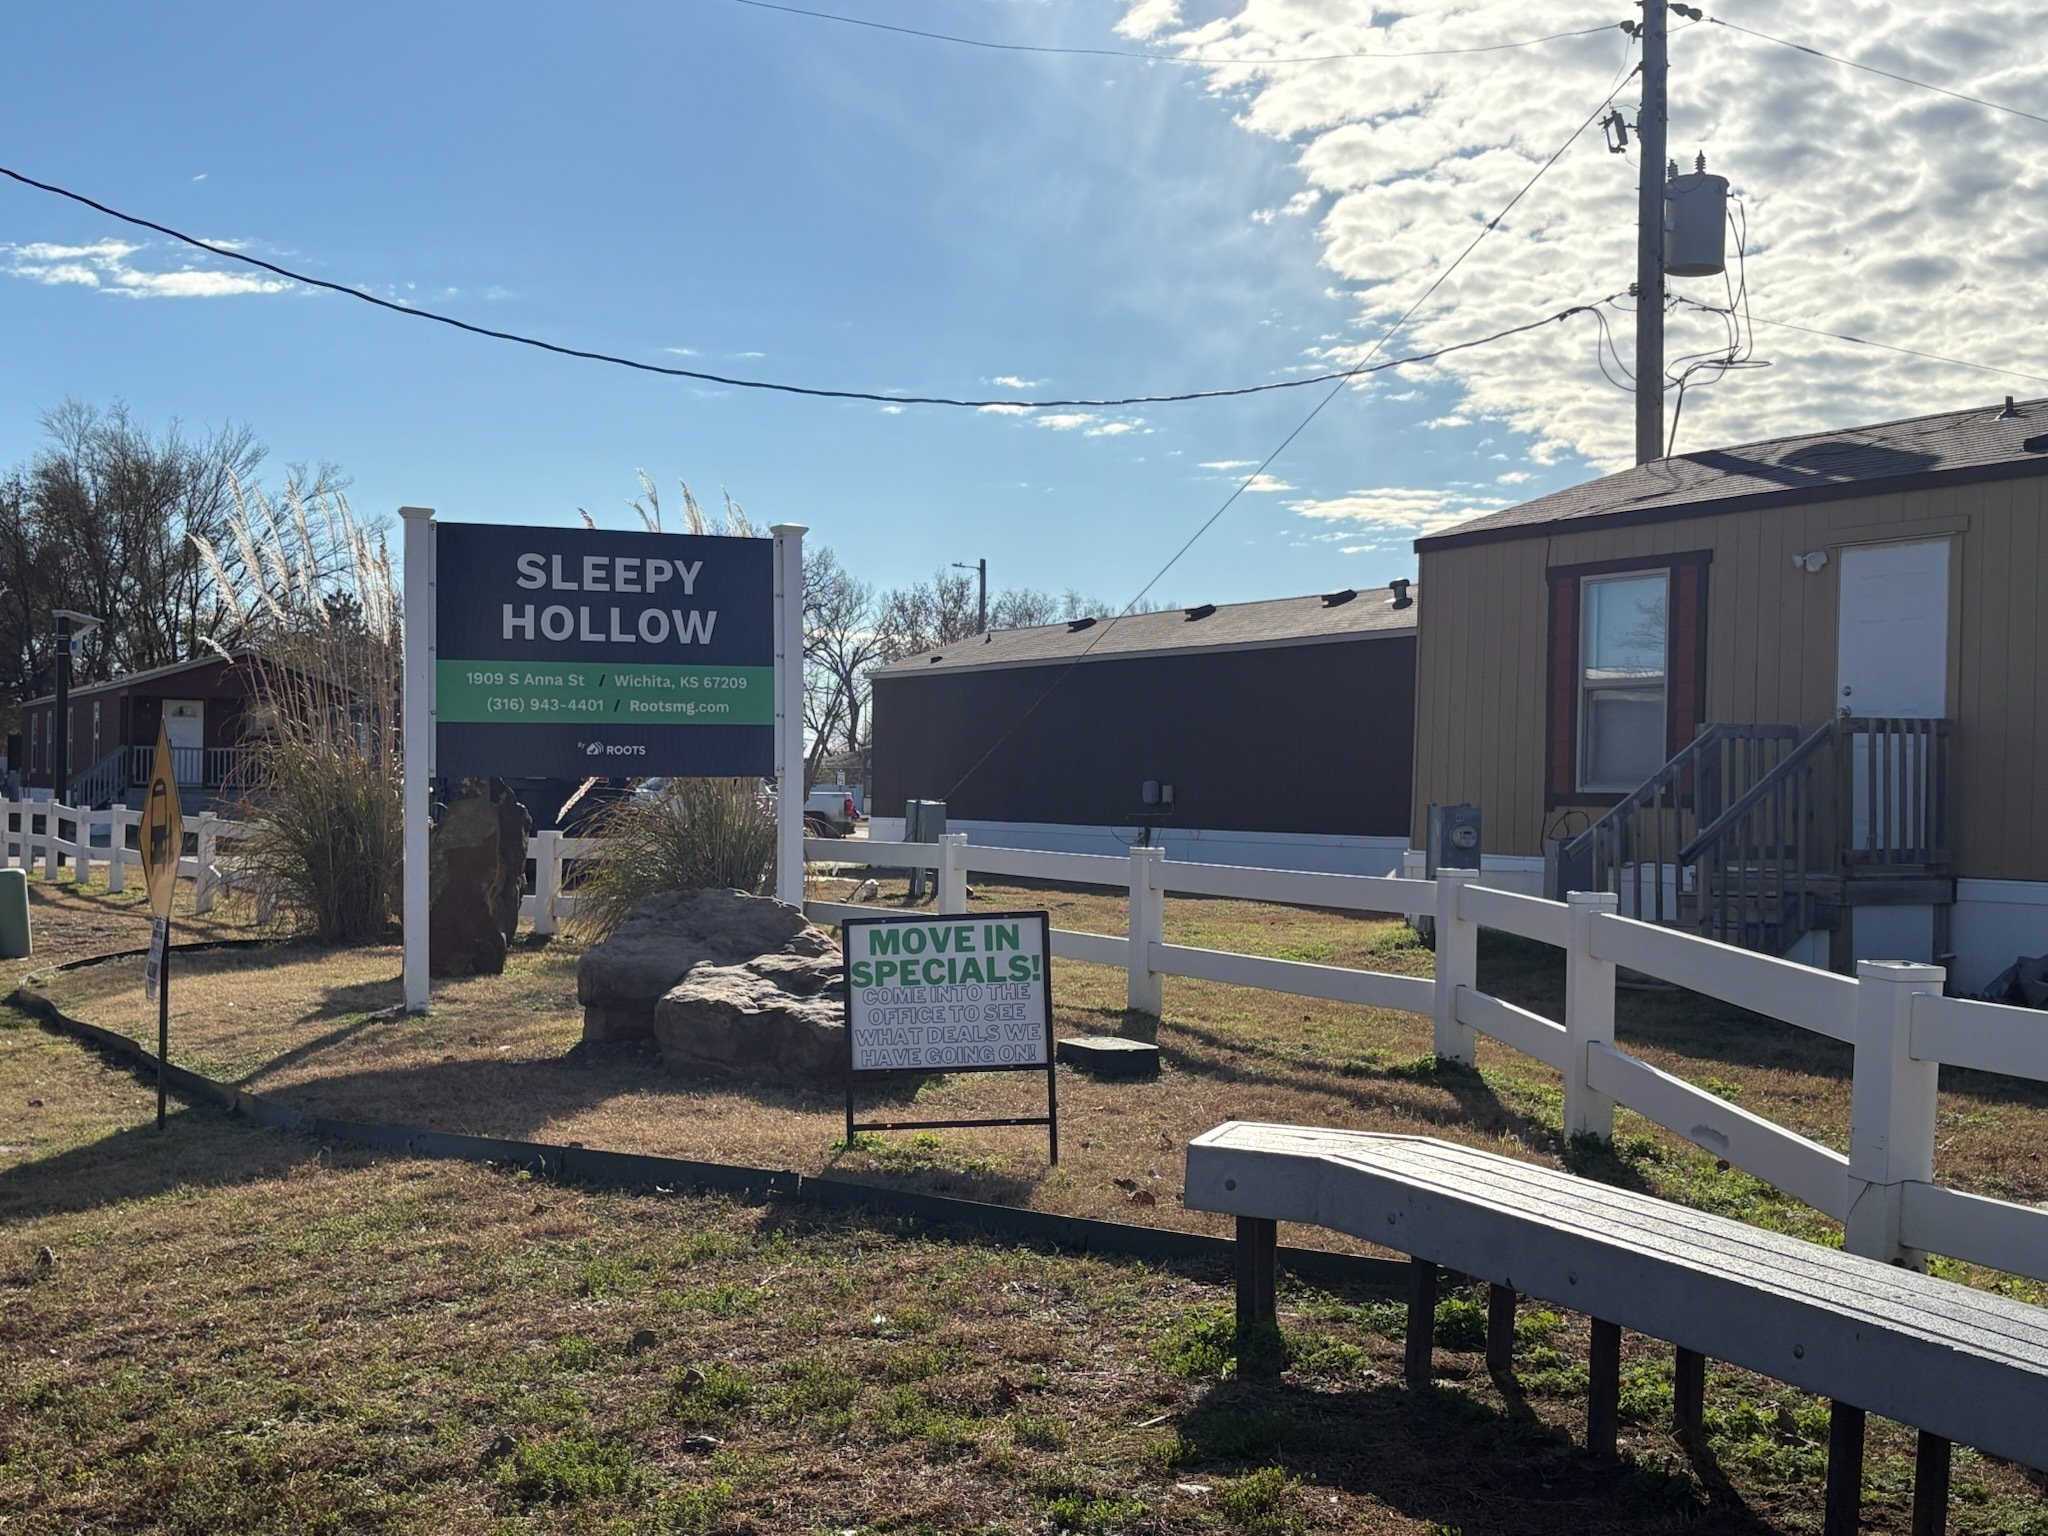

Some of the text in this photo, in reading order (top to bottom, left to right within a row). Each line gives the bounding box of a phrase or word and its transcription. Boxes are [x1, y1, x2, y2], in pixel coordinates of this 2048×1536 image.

[516, 552, 704, 595] SLEEPY
[502, 603, 718, 645] HOLLOW
[466, 672, 504, 685] 1909
[509, 673, 520, 686] S
[523, 673, 563, 687] Anna
[568, 674, 585, 687] St
[614, 674, 676, 690] Wichita,
[680, 677, 699, 689] KS
[703, 676, 748, 689] 67209
[487, 697, 525, 713] (316)
[530, 698, 604, 712] 943-4401
[630, 699, 730, 716] Rootsmg.com
[606, 745, 646, 756] ROOTS
[869, 924, 1020, 956] MOVE IN
[851, 954, 1041, 988] SPECIALS!
[862, 982, 1031, 1006] COME INTO THE
[868, 1002, 1027, 1026] OFFICE TO SEE
[855, 1022, 1042, 1047] WHAT DEALS WE
[860, 1043, 1037, 1068] HAVE GOING ON!
